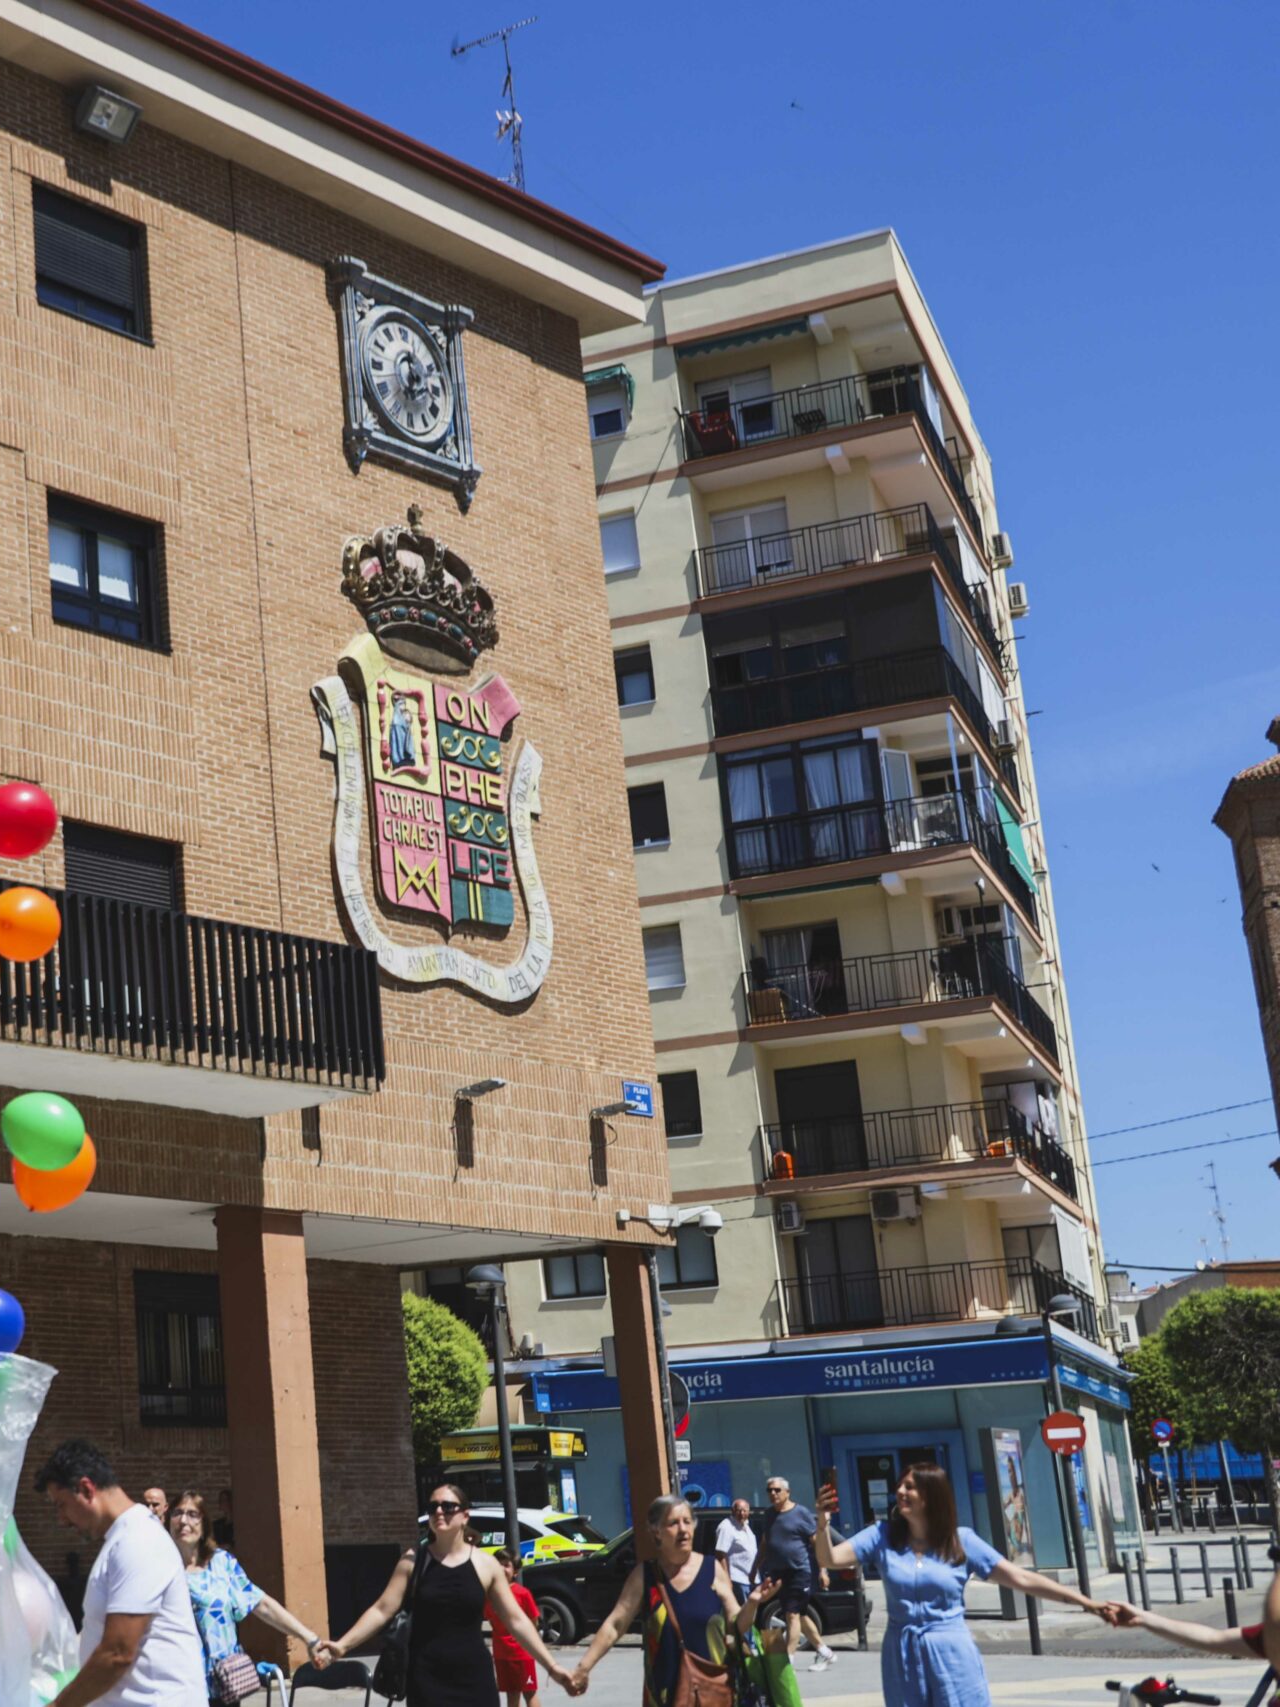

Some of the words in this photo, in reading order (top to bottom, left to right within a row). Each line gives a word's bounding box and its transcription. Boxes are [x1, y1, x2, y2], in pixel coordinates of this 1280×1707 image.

[447, 692, 490, 730] ON
[446, 764, 505, 808] PHE
[452, 843, 511, 884] LIPE
[824, 1355, 935, 1379] santalucía
